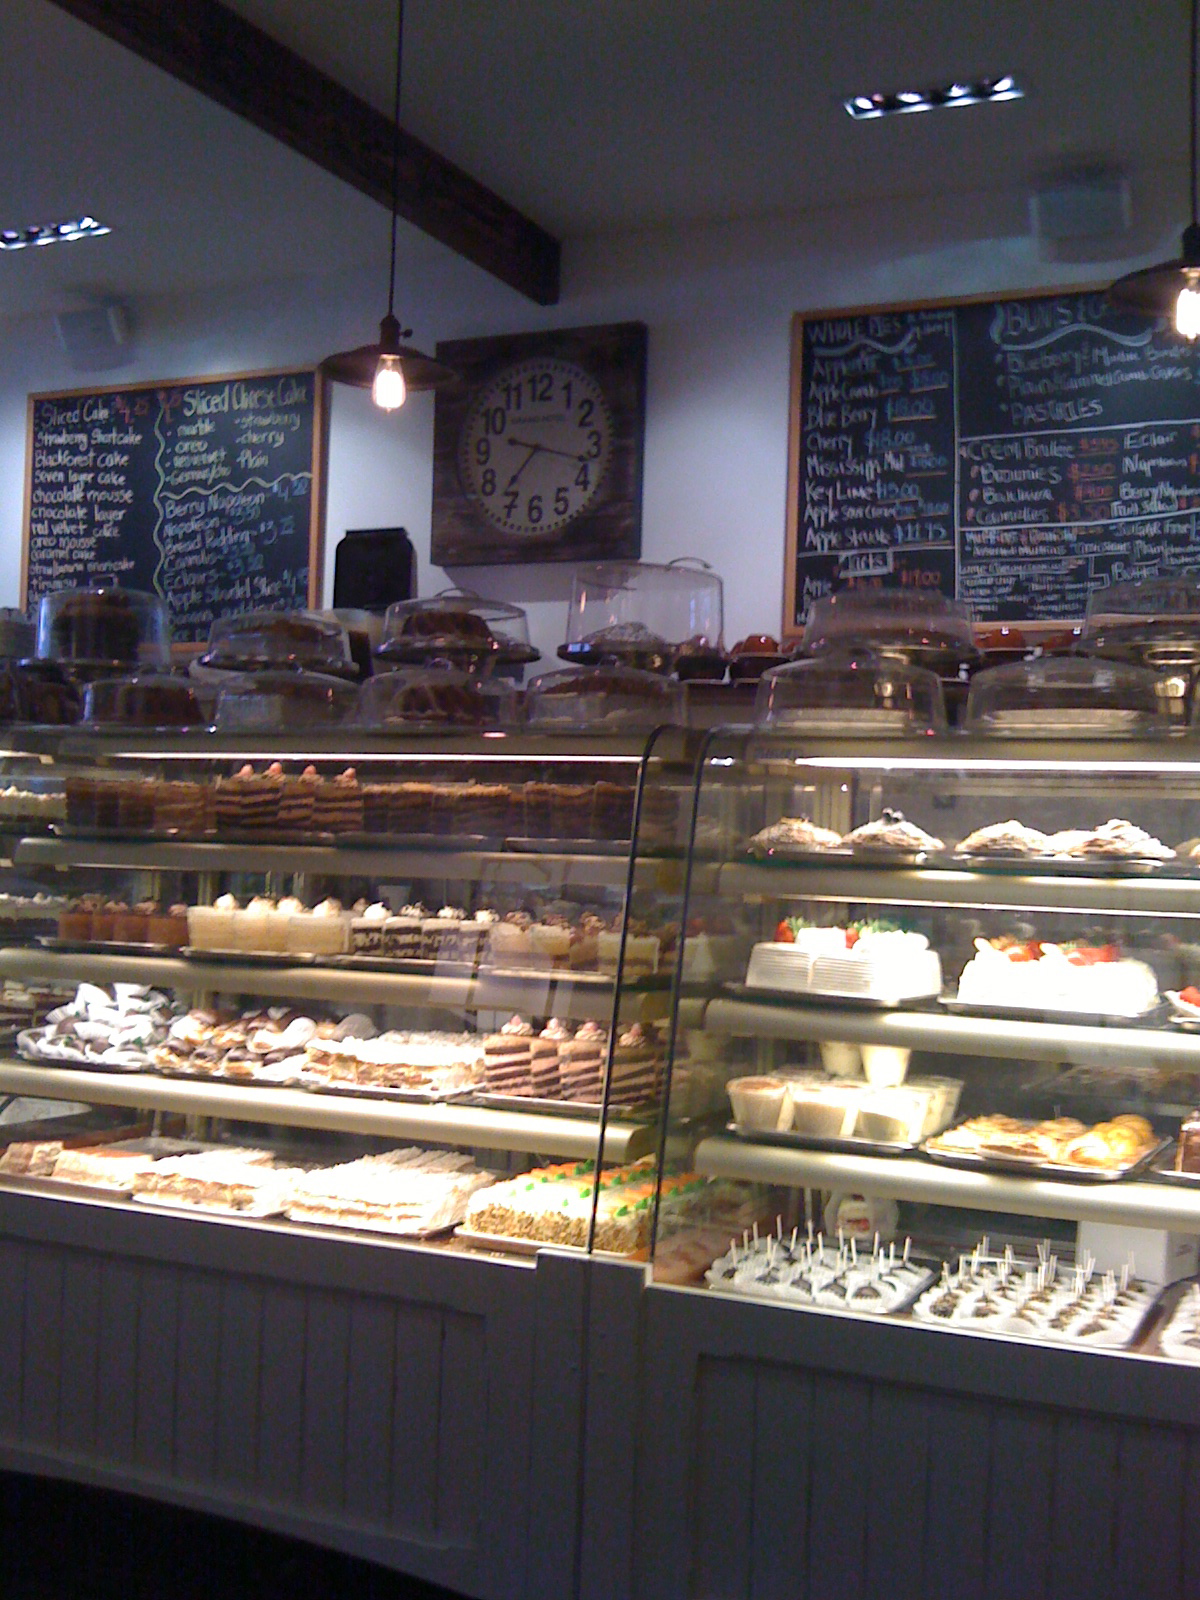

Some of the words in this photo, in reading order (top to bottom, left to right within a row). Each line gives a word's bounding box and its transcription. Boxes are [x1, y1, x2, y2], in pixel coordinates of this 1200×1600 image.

[500, 382, 522, 410] 11
[528, 373, 553, 402] 12
[562, 381, 573, 409] 1
[183, 387, 229, 417] Sliced
[577, 399, 594, 427] 2
[481, 407, 506, 435] 10
[476, 438, 491, 465] 9
[587, 430, 602, 459] 3
[1122, 431, 1178, 451] Eclair
[481, 468, 496, 496] 8
[575, 463, 590, 491] 4
[504, 491, 519, 518] 7
[527, 495, 543, 523] 6
[554, 487, 570, 515] 5
